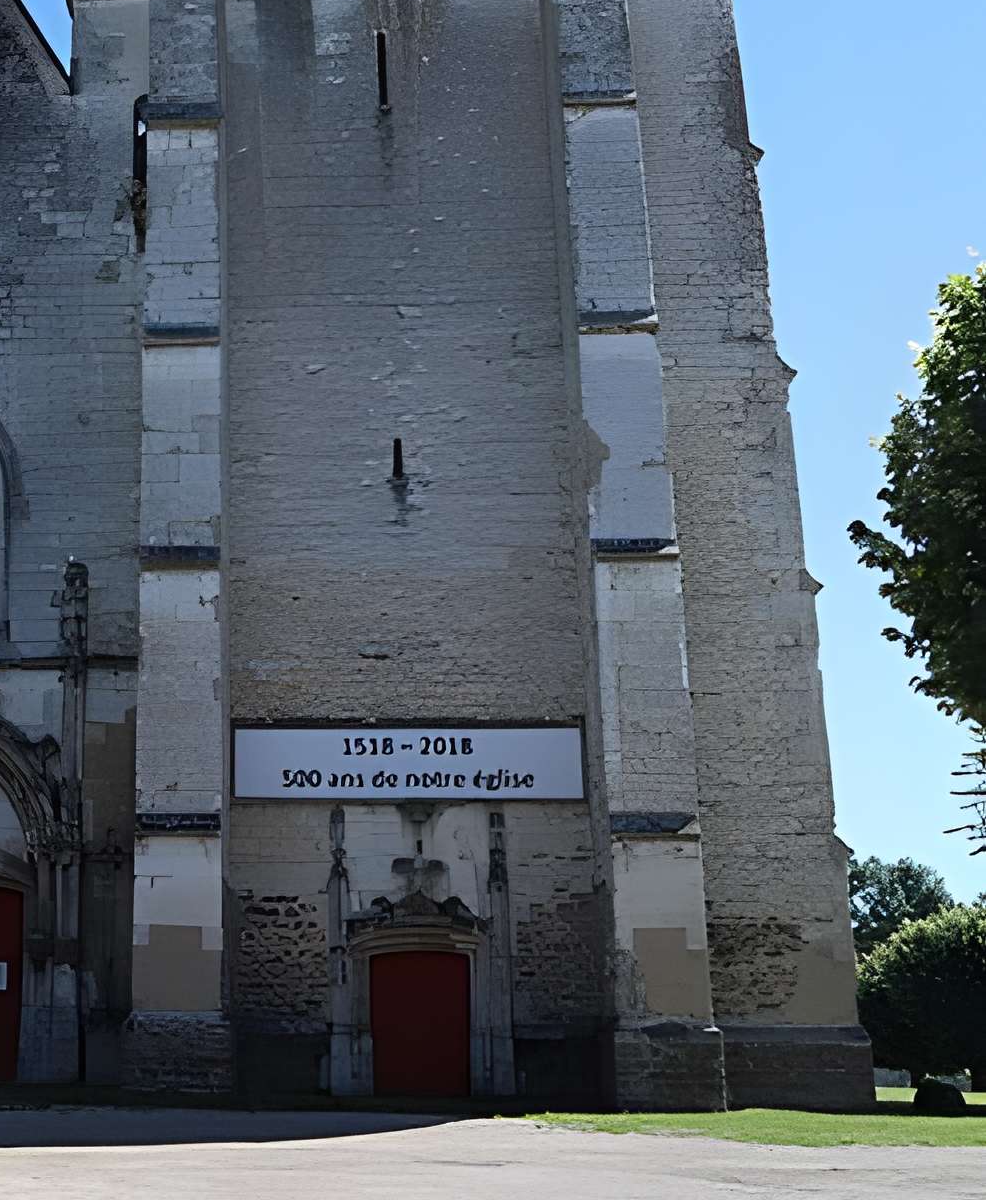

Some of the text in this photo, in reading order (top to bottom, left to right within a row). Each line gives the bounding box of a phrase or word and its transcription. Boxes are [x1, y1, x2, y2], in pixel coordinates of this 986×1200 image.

[342, 737, 395, 756] 1518
[419, 736, 474, 756] 2018
[281, 768, 323, 790] 500
[371, 770, 399, 788] de
[405, 771, 467, 789] notre
